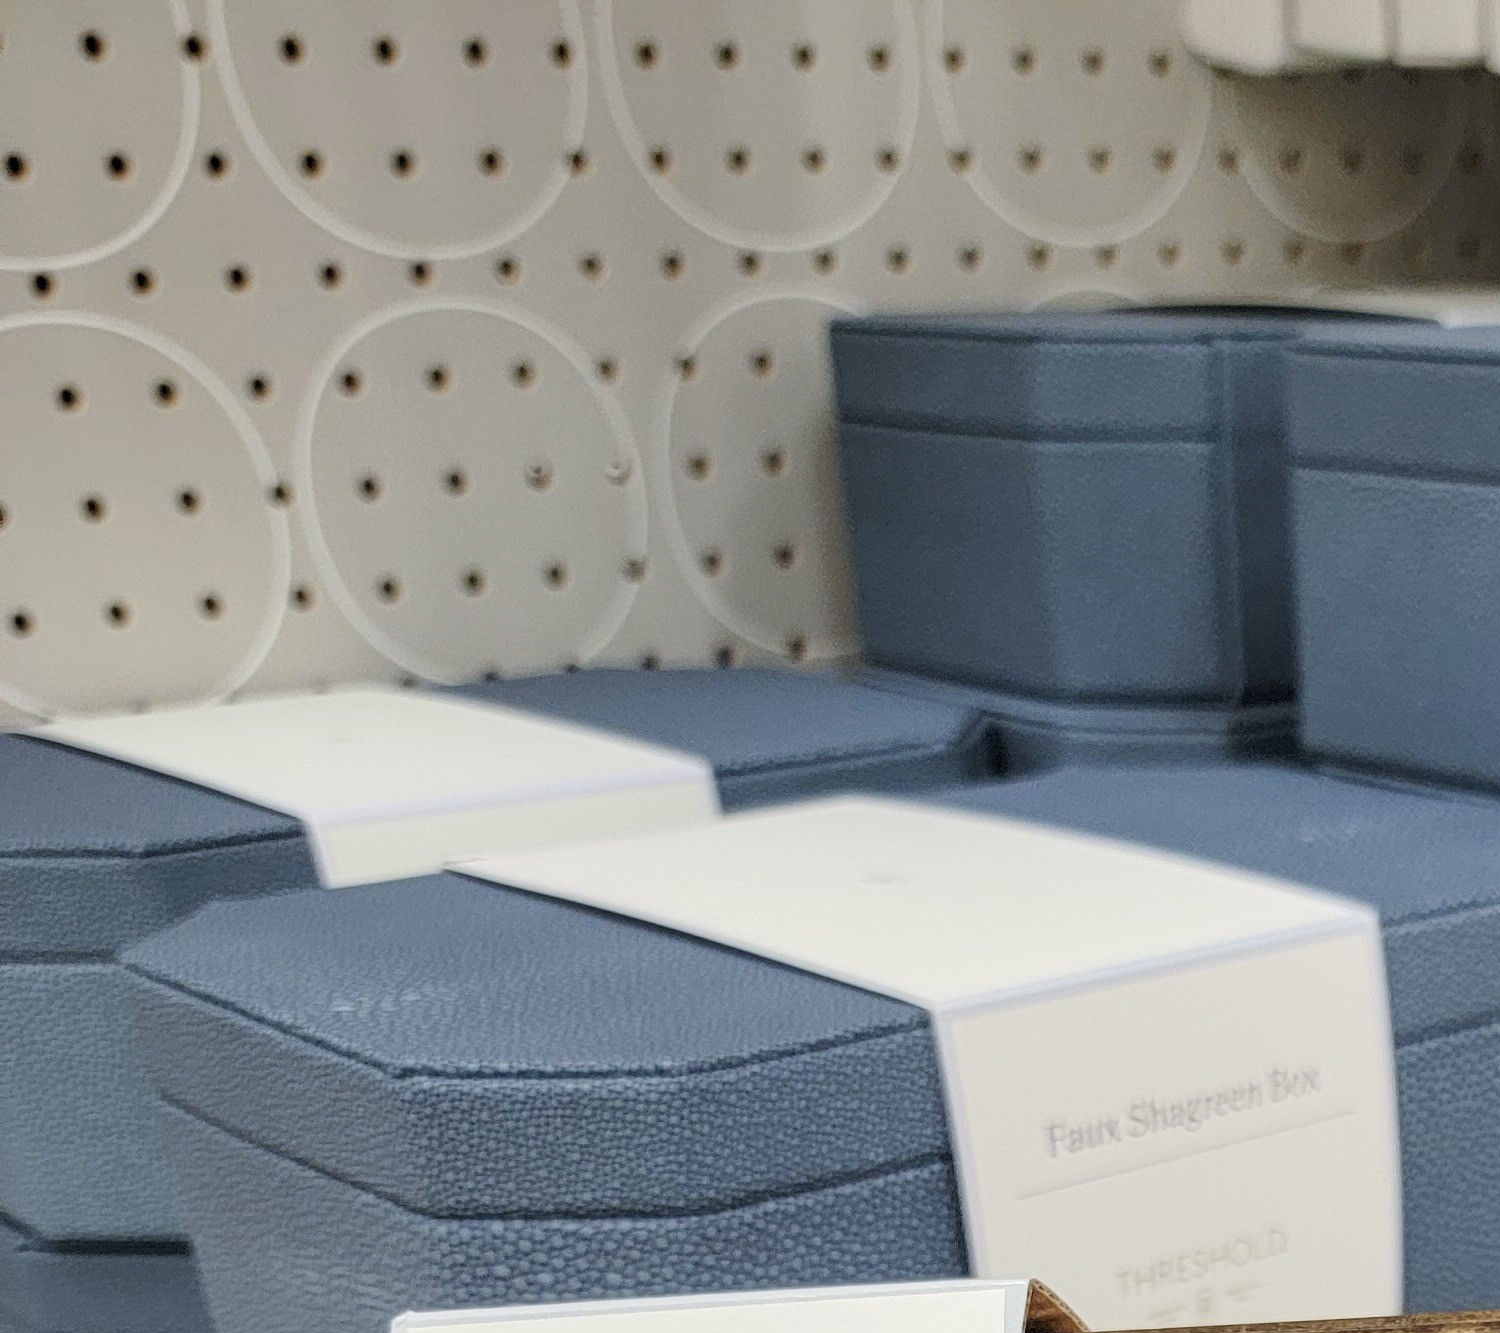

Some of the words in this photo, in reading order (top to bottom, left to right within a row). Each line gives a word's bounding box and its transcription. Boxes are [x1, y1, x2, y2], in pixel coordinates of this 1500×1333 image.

[1043, 1116, 1122, 1159] Faux
[1126, 1082, 1264, 1138] Shagreen
[1267, 1066, 1321, 1103] Box
